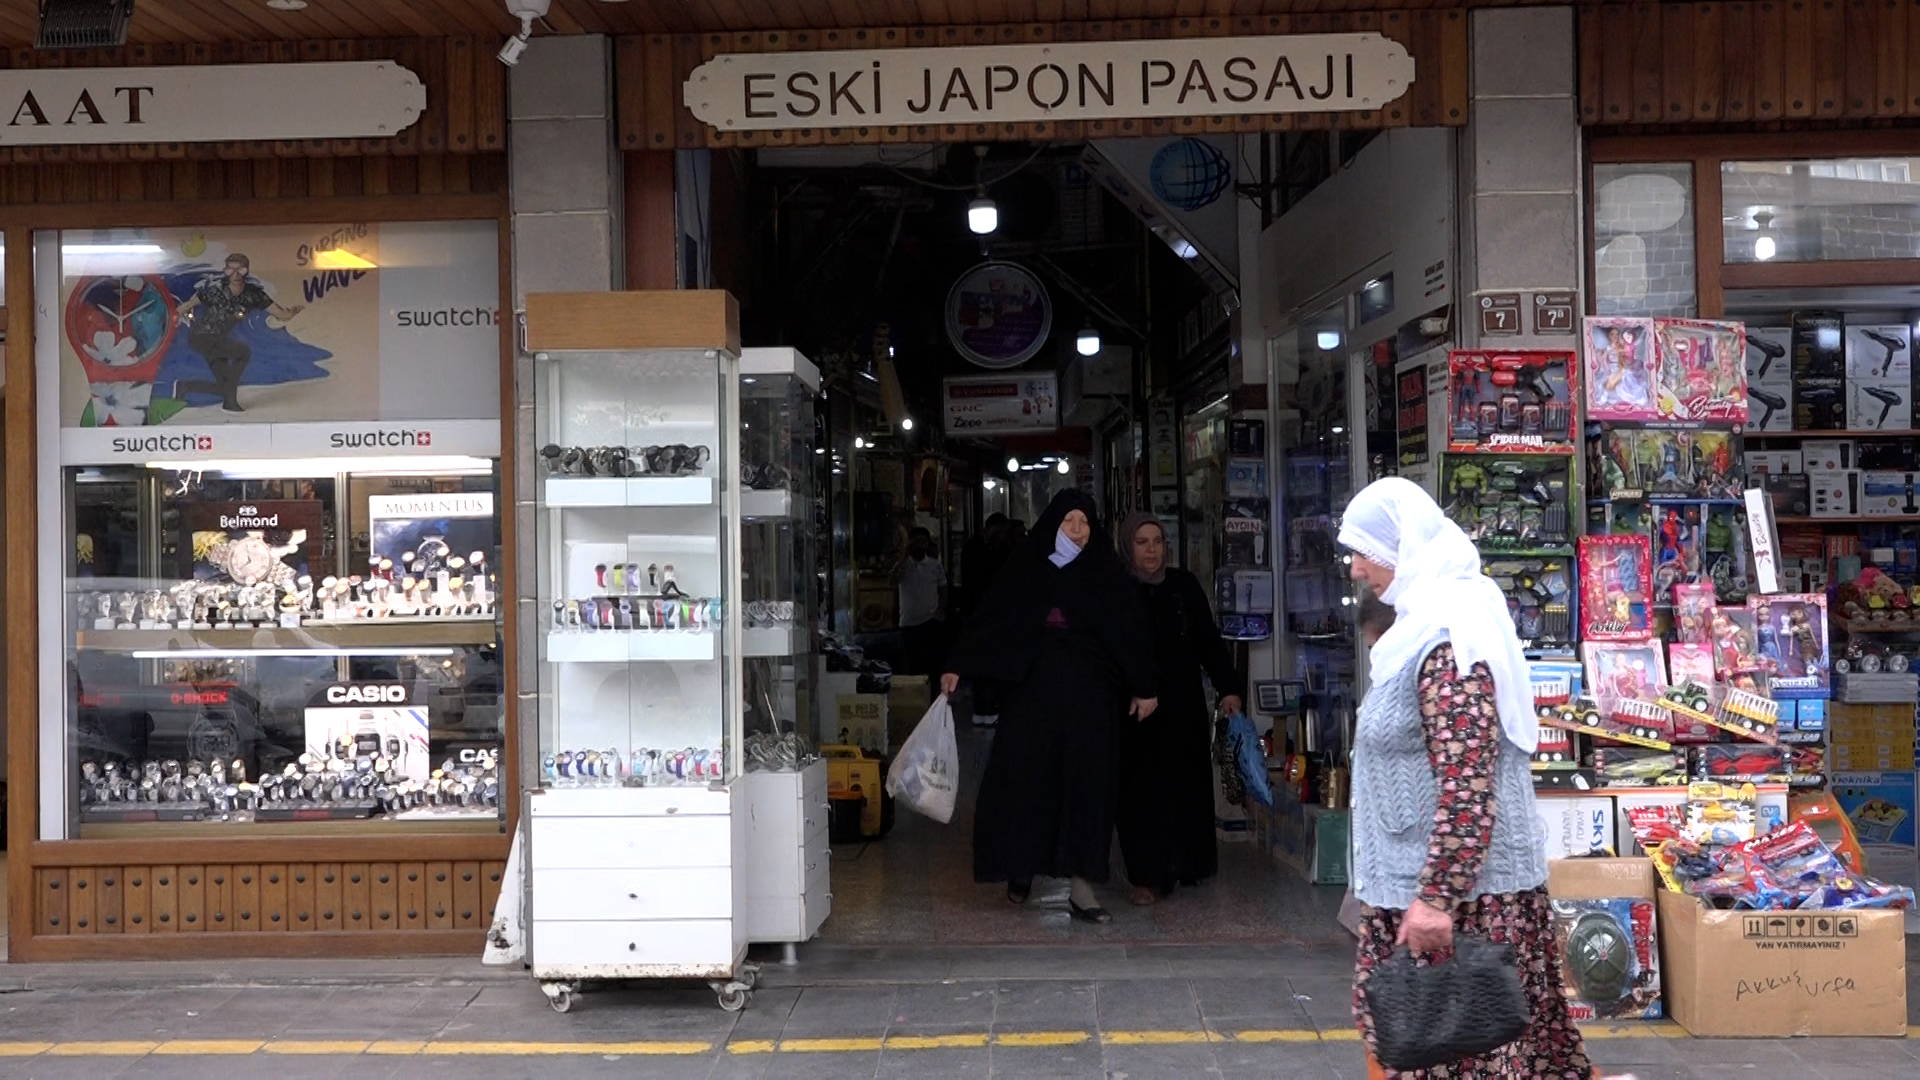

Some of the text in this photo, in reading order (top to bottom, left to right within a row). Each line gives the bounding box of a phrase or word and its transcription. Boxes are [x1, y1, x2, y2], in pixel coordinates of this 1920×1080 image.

[743, 53, 1354, 119] ESKİ JAPON PASAJI
[396, 306, 493, 329] swatch
[1495, 311, 1506, 328] 7
[112, 435, 198, 453] swatch
[330, 430, 416, 449] swatch
[385, 498, 484, 515] MOMENTUS
[220, 513, 279, 529] Belmond
[327, 685, 406, 704] CASIO
[1755, 941, 1774, 950] YAN
